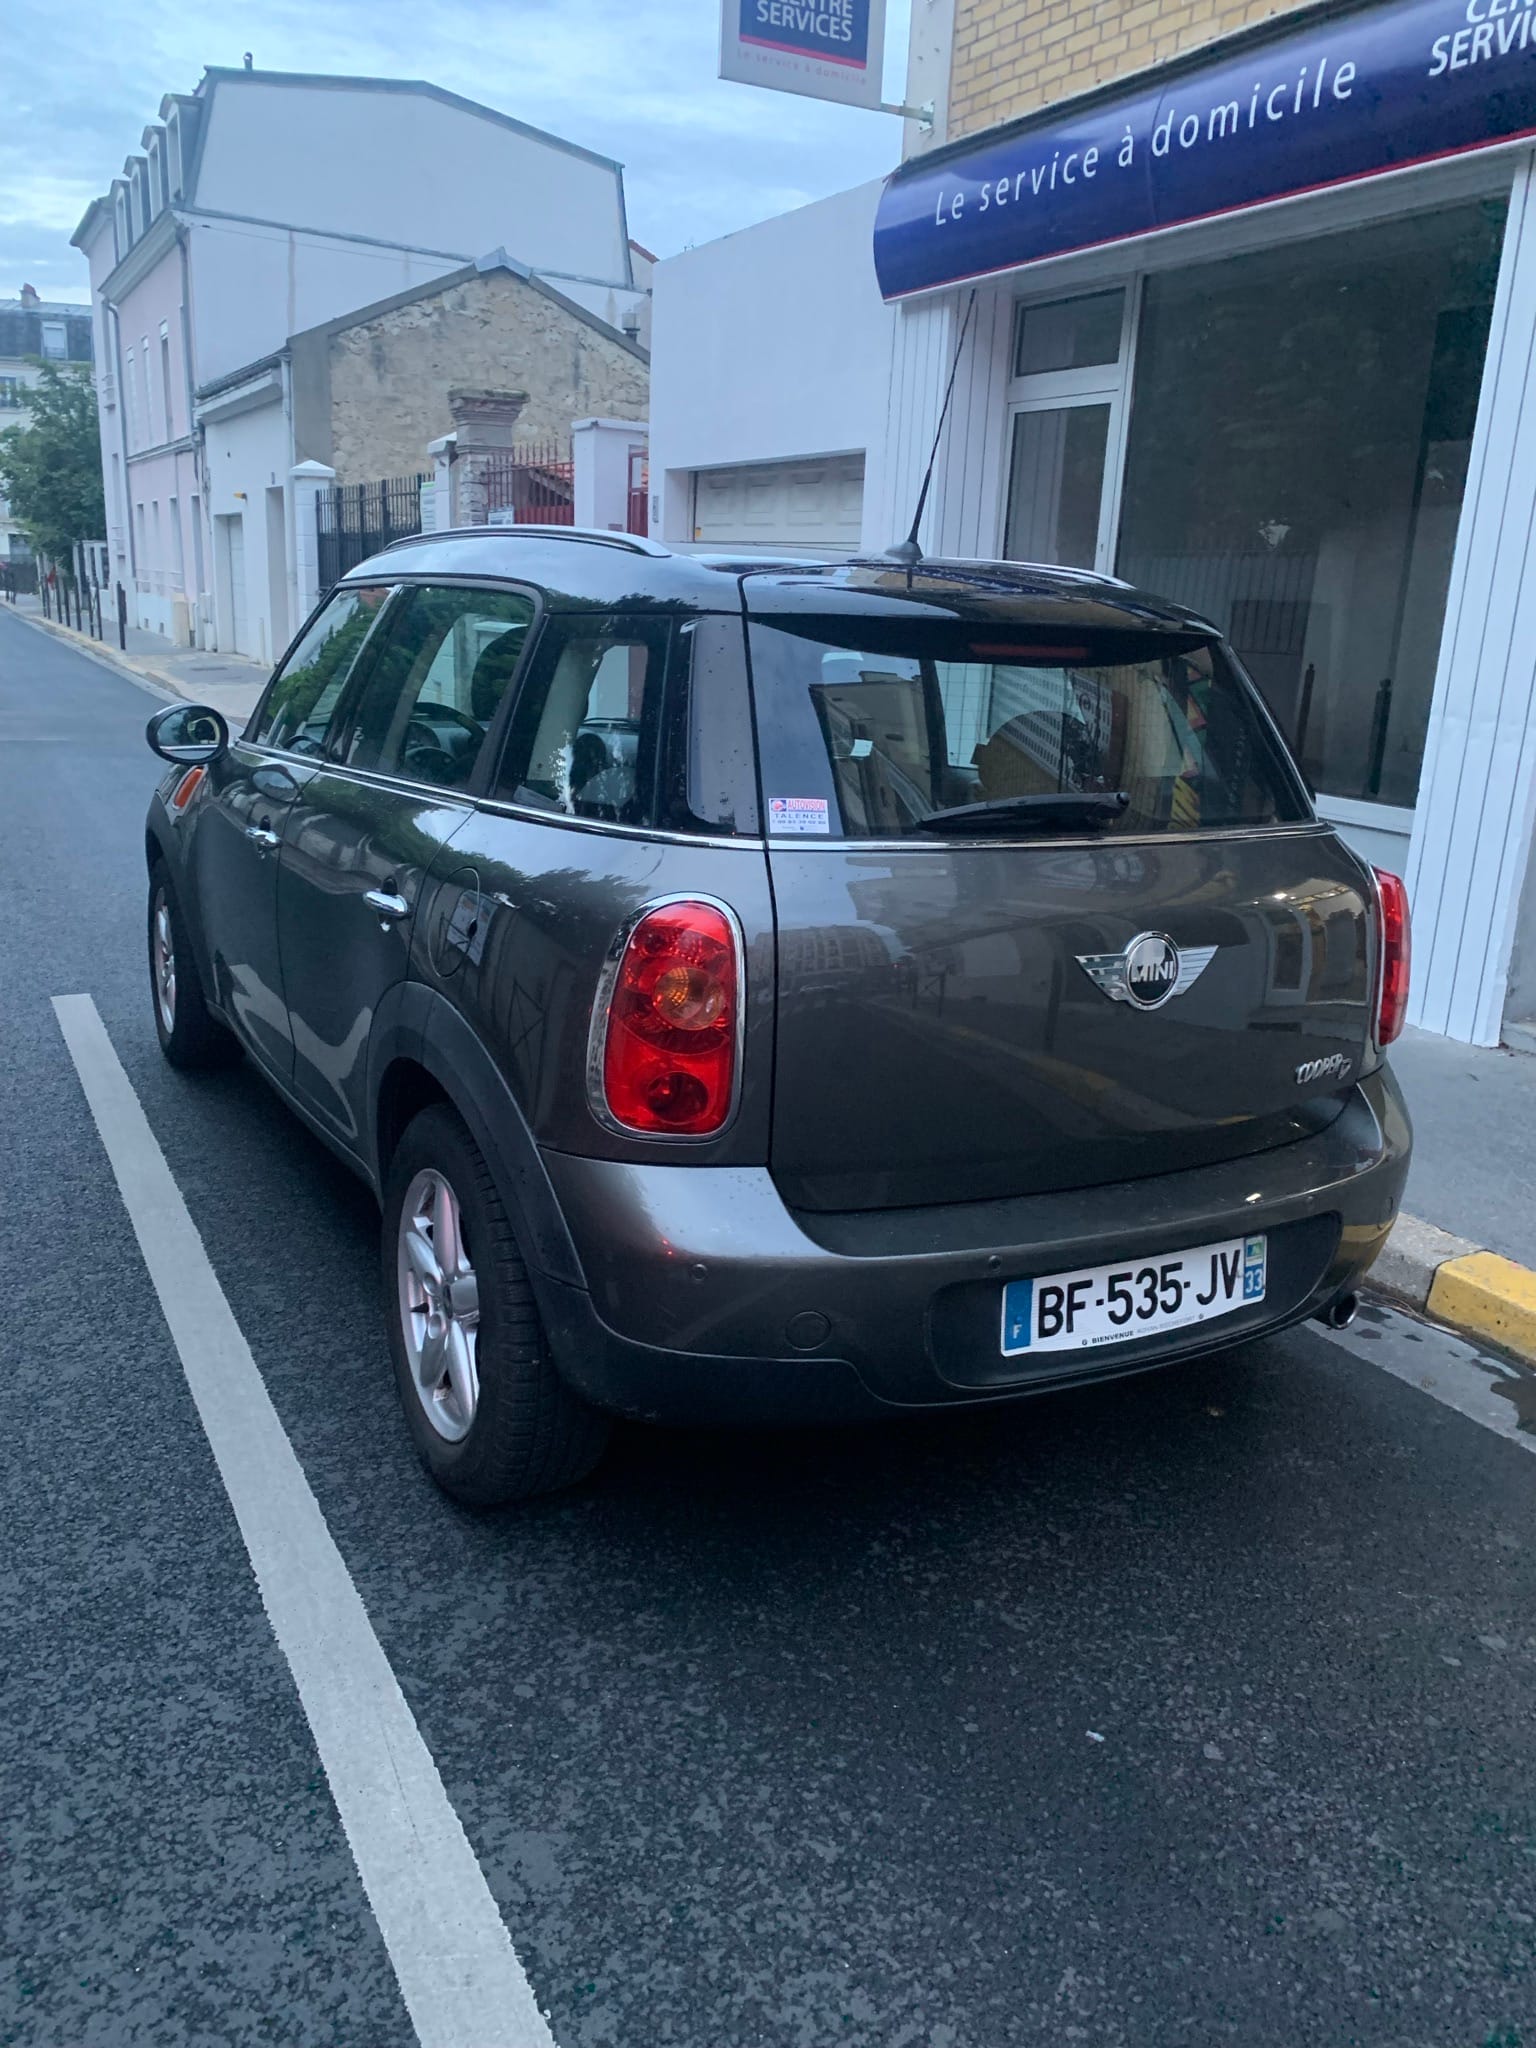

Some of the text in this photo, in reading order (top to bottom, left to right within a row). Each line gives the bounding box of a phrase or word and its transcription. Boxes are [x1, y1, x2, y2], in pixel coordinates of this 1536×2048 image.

[756, 0, 853, 42] SERVICES
[778, 0, 853, 19] NTRE
[1428, 10, 1536, 77] SERVI
[936, 57, 1356, 226] Le service à domicile
[1131, 960, 1174, 983] MINI
[1296, 1053, 1343, 1085] COOPER
[1038, 1249, 1241, 1339] BF-535-JV
[1245, 1268, 1264, 1294] 33
[1012, 1324, 1021, 1339] F
[1091, 1330, 1134, 1344] BIENVENUE
